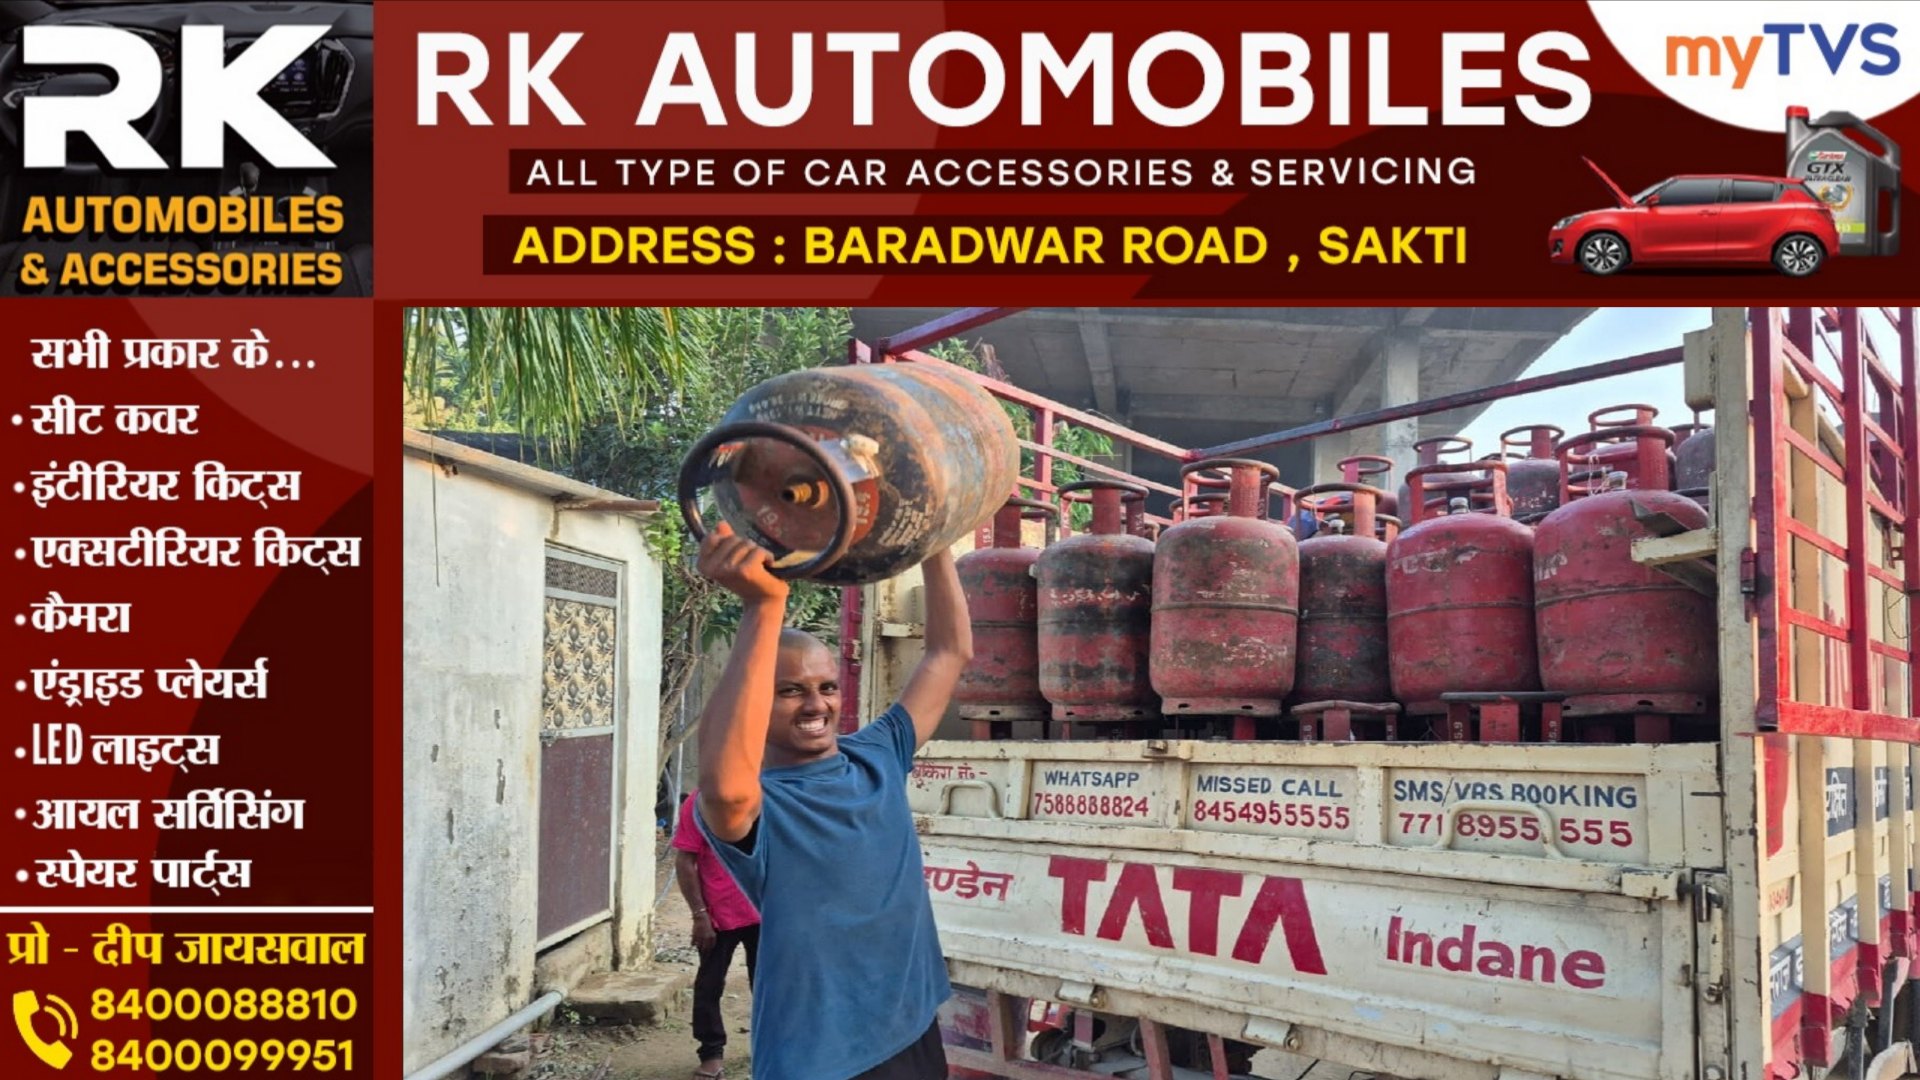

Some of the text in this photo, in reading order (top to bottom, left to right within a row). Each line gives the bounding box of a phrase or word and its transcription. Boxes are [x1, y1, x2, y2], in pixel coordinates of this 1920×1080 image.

[1807, 162, 1845, 174] GTX
[1044, 769, 1140, 789] WHATSAPP
[1197, 774, 1344, 798] MISSED CALL
[1034, 793, 1150, 818] 7588888824
[1511, 782, 1638, 809] BOOKING
[1193, 799, 1351, 830] 8454955555
[1048, 854, 1328, 976] TATA
[1386, 916, 1606, 990] Indane
